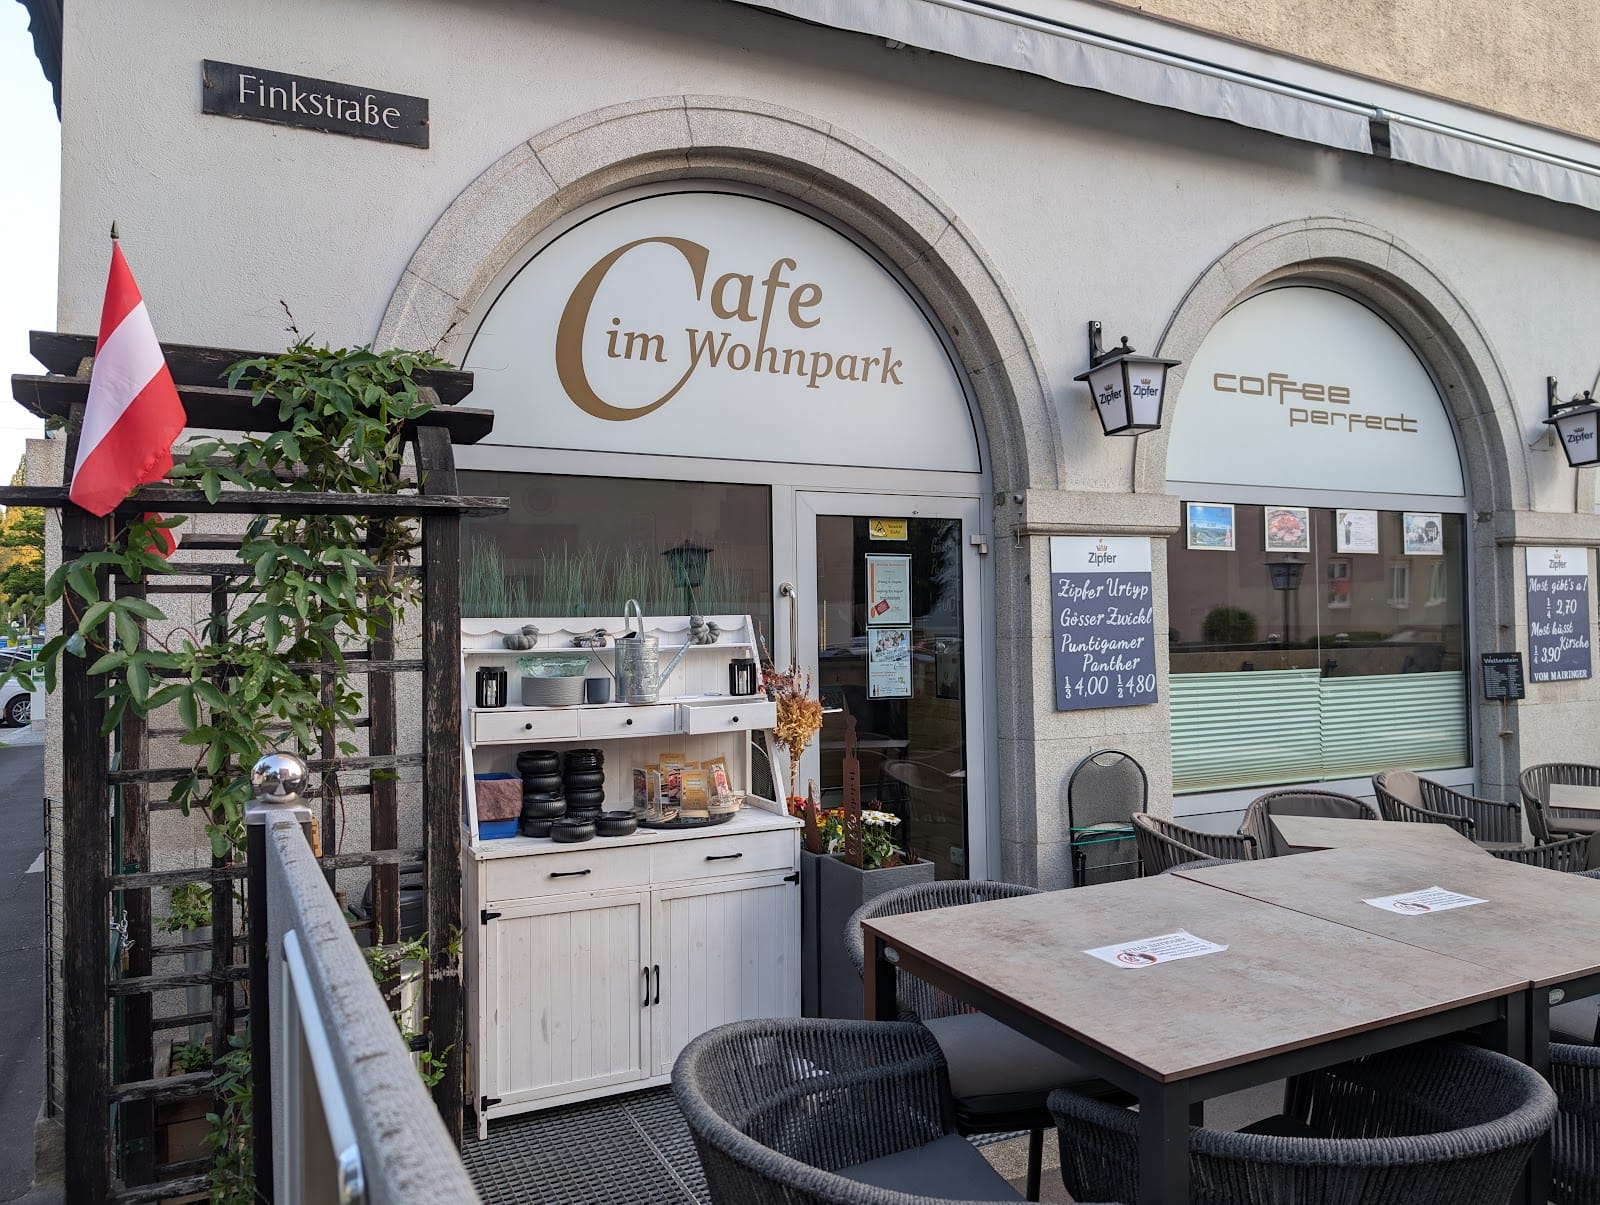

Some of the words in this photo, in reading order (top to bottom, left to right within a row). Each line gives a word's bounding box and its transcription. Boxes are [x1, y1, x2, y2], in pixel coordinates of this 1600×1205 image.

[238, 73, 401, 129] Finkstraße
[555, 236, 823, 421] Cafe
[606, 317, 668, 362] im
[685, 327, 904, 388] Wohnpark
[1099, 389, 1122, 405] Zipfer
[1133, 384, 1159, 399] Zipfer
[1213, 372, 1351, 405] coffee
[1289, 407, 1418, 433] perfect
[1567, 432, 1593, 444] Zipfer
[1088, 552, 1116, 566] Zipfer
[1548, 559, 1567, 571] Zipfer
[1058, 579, 1104, 602] Zipfer
[1107, 578, 1148, 600] Urtyp
[1528, 577, 1549, 593] Most
[1556, 599, 1577, 616] 2,70
[1060, 607, 1105, 627] Gösser
[1106, 607, 1152, 625] Zwickl
[1531, 621, 1551, 637] Most
[1061, 633, 1145, 654] Puntigamer
[1082, 653, 1141, 673] Panther
[1541, 646, 1561, 664] 3,90
[1533, 672, 1550, 681] VOM
[1550, 669, 1588, 680] MAIRINGER
